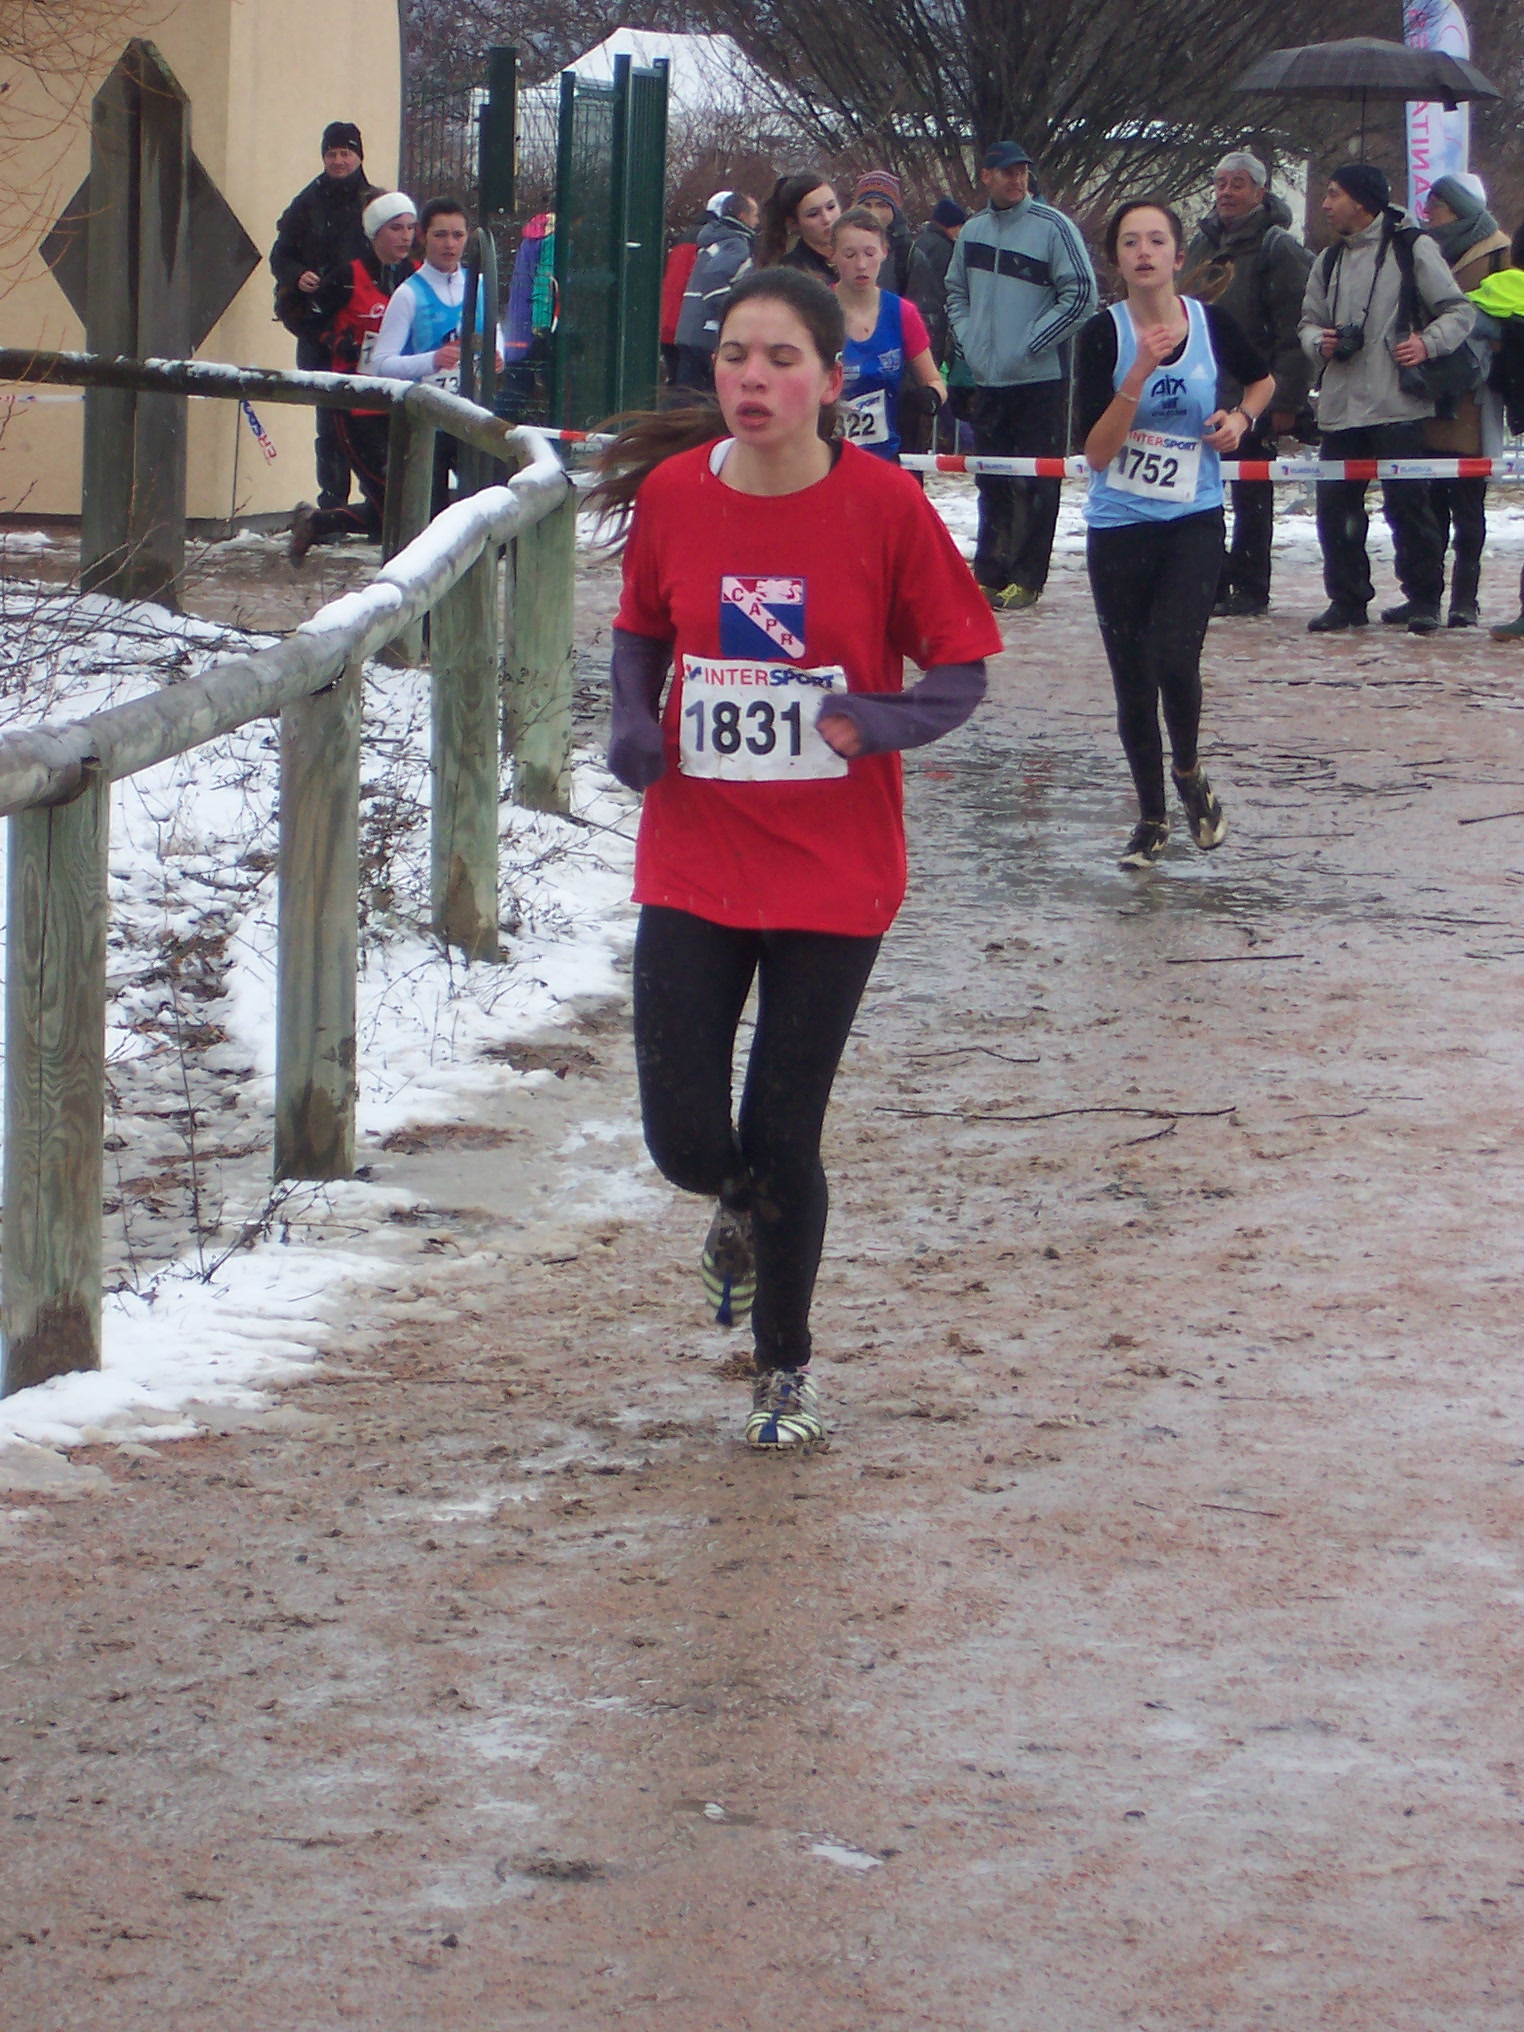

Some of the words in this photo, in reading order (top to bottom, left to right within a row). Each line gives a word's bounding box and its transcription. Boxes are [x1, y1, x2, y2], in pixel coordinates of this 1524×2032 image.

[1118, 445, 1179, 488] 1752
[705, 666, 834, 689] INTERSPORT
[685, 699, 801, 757] 1831
